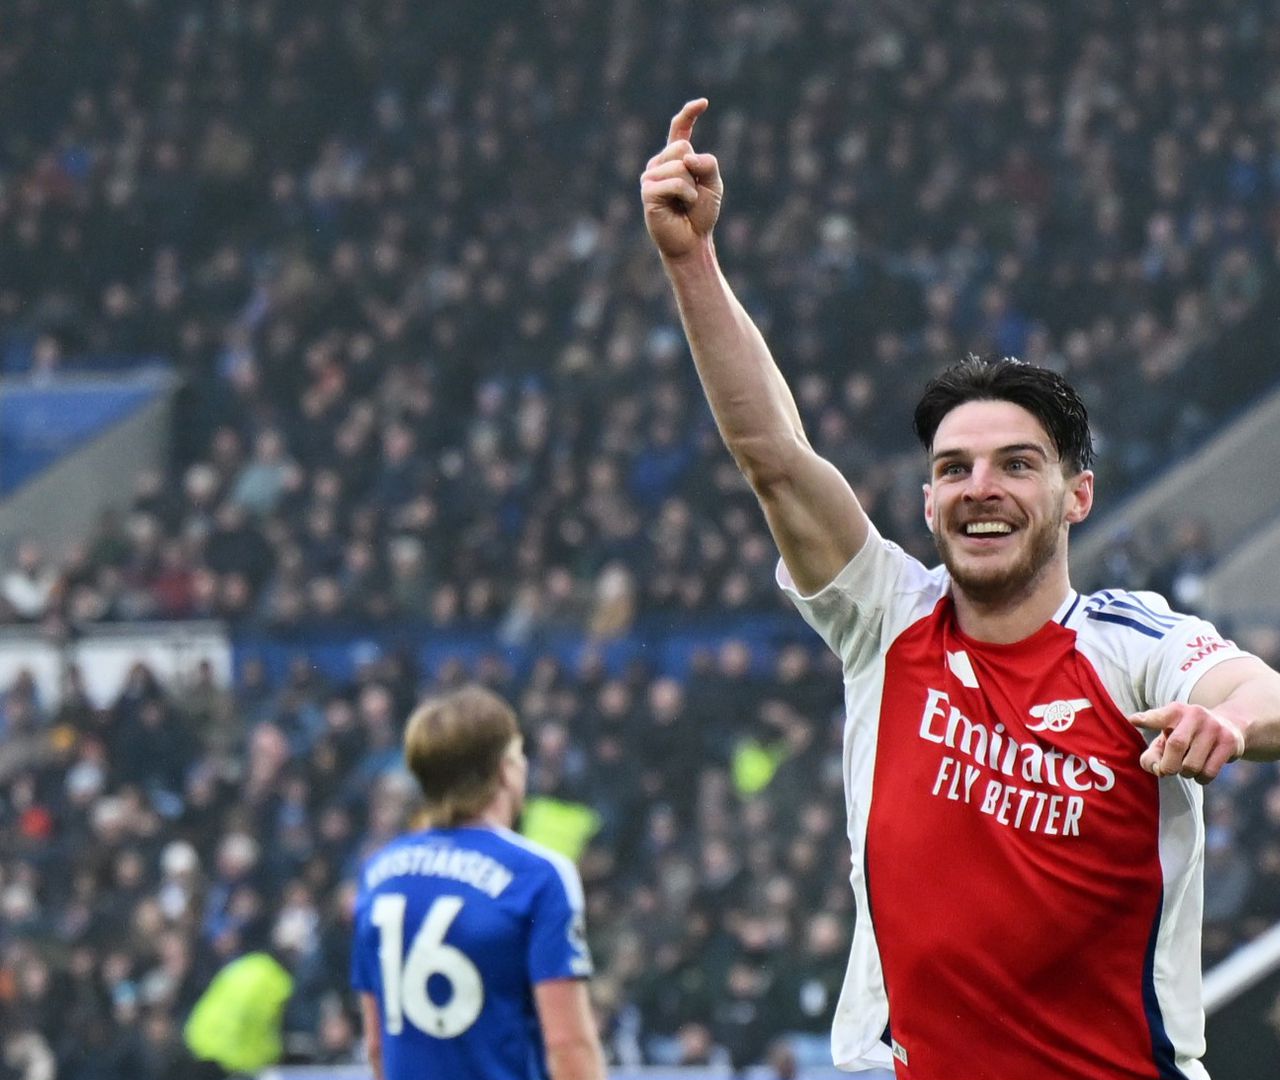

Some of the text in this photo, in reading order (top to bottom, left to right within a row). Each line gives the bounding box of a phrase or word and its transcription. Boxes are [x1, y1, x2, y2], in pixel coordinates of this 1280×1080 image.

[919, 687, 1116, 792] Emirates
[931, 755, 1084, 837] FLY BETTER
[371, 893, 484, 1039] 16
